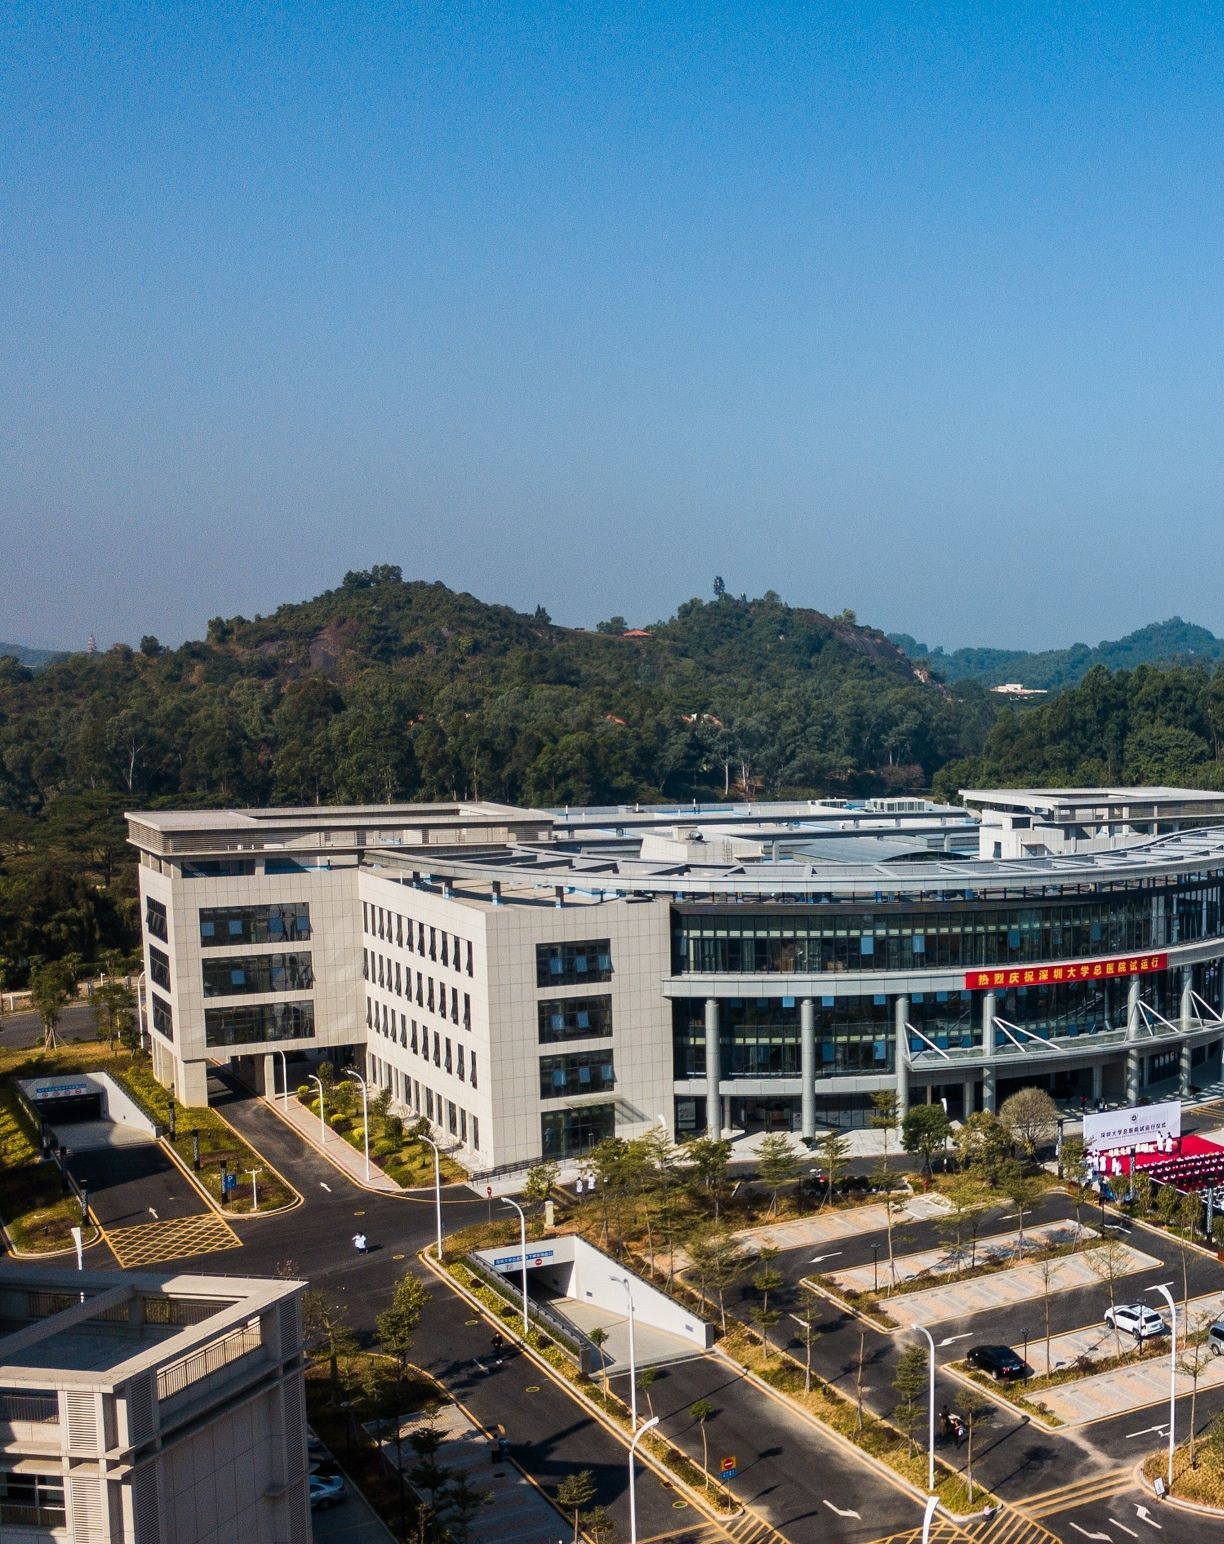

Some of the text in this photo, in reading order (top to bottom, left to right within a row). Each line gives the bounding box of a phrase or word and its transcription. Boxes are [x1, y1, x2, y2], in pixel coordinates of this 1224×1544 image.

[978, 957, 1160, 986] 热烈庆祝深圳大学总医院试运行
